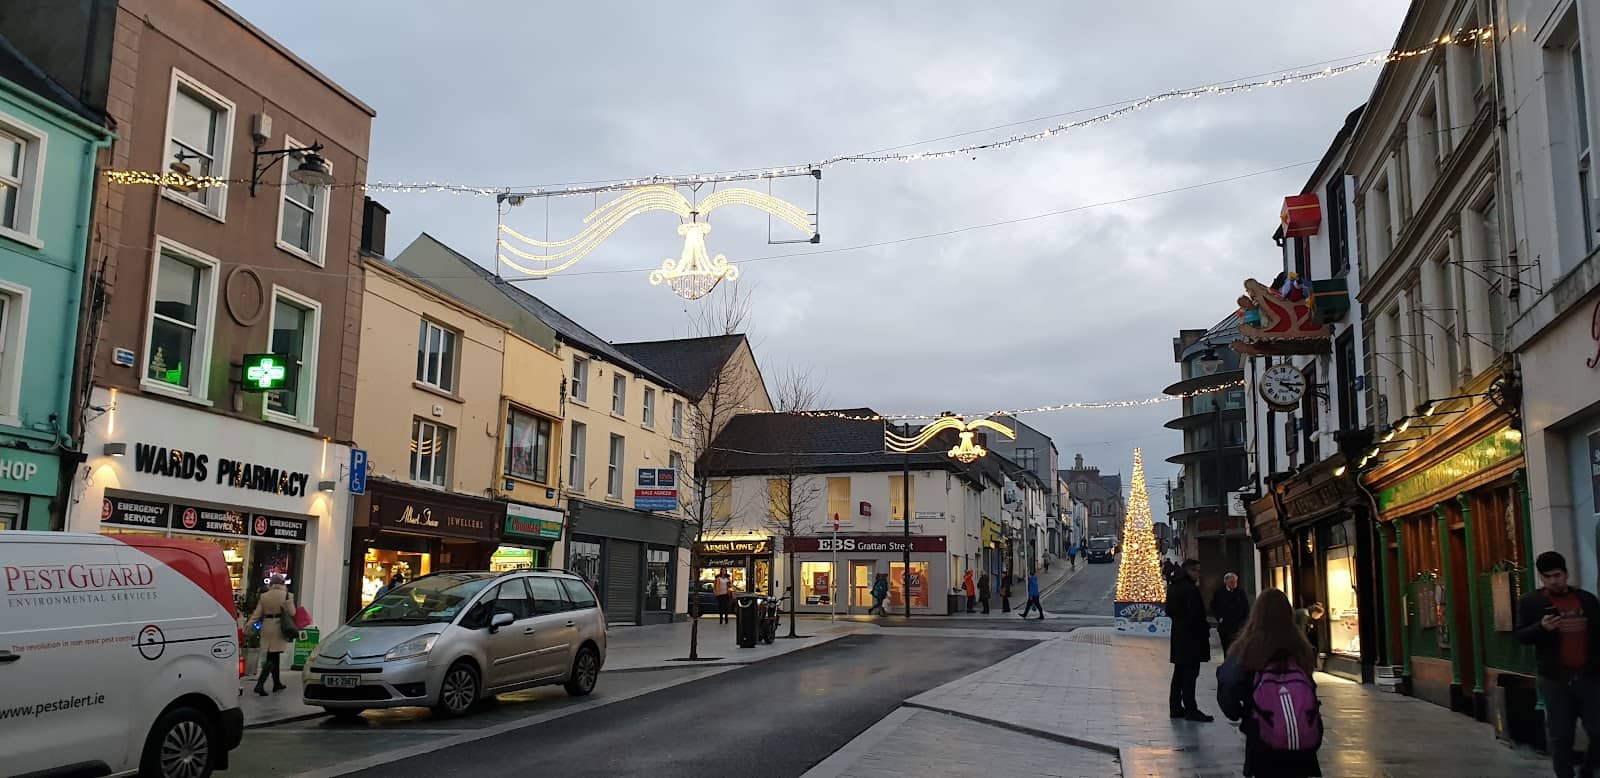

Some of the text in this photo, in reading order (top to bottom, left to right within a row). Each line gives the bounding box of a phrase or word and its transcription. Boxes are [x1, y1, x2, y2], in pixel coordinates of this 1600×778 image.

[135, 442, 310, 497] WARDS PHARMACY
[117, 502, 165, 514] EMERGENCY
[124, 513, 157, 524] SERVICE
[201, 511, 241, 523] EMERGENCY
[206, 521, 234, 531] SERVICE
[269, 519, 304, 529] EMERGENCY
[274, 528, 298, 537] SERVICE
[730, 542, 753, 550] LOWE
[818, 538, 914, 551] EBS Grattan Stret
[8, 591, 159, 608] ENVIRONMENTAL SERVICES
[0, 692, 104, 719] www.pestalert.ie
